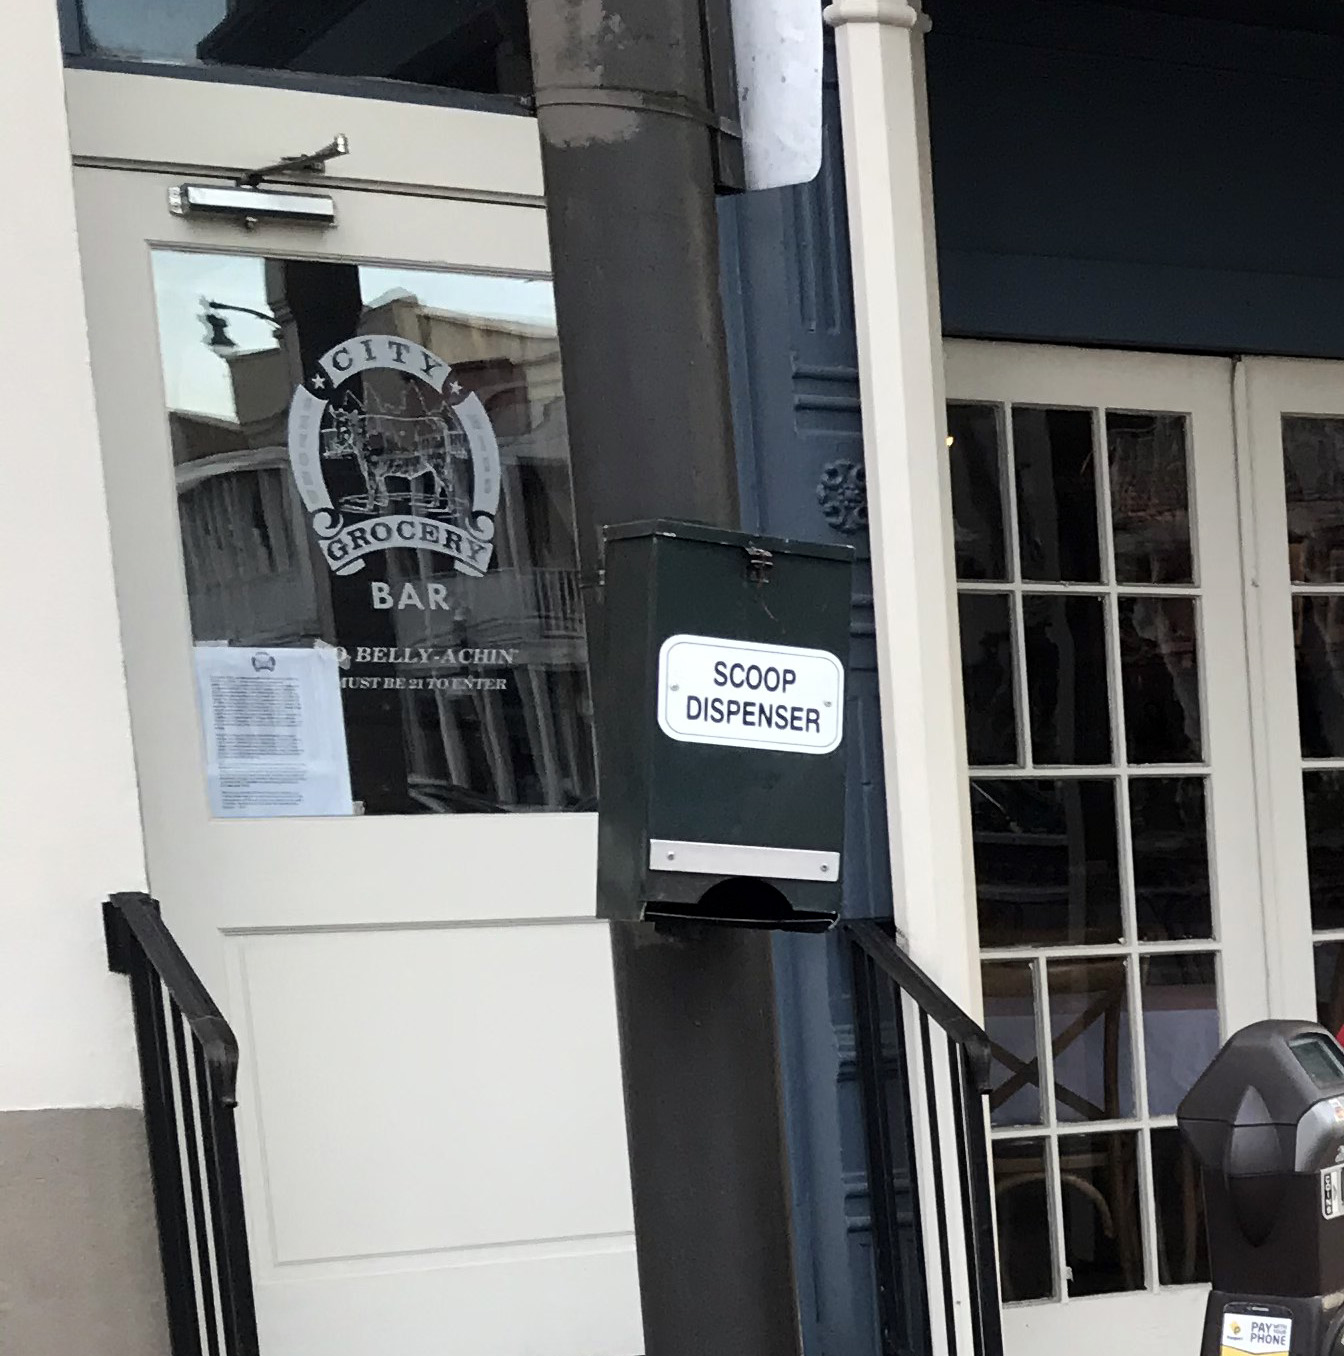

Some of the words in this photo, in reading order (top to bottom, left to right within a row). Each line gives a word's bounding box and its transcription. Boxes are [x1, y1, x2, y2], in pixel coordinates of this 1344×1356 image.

[331, 339, 444, 378] CITY
[327, 521, 488, 563] GROCERY
[371, 581, 450, 611] BAR
[383, 677, 406, 689] BE
[408, 678, 424, 690] 21
[426, 678, 449, 690] TO
[452, 678, 507, 690] ENTER
[713, 660, 797, 693] SCOOP
[686, 695, 821, 734] DISPENSER
[1250, 1333, 1286, 1346] PHONE
[1251, 1321, 1272, 1333] PAY
